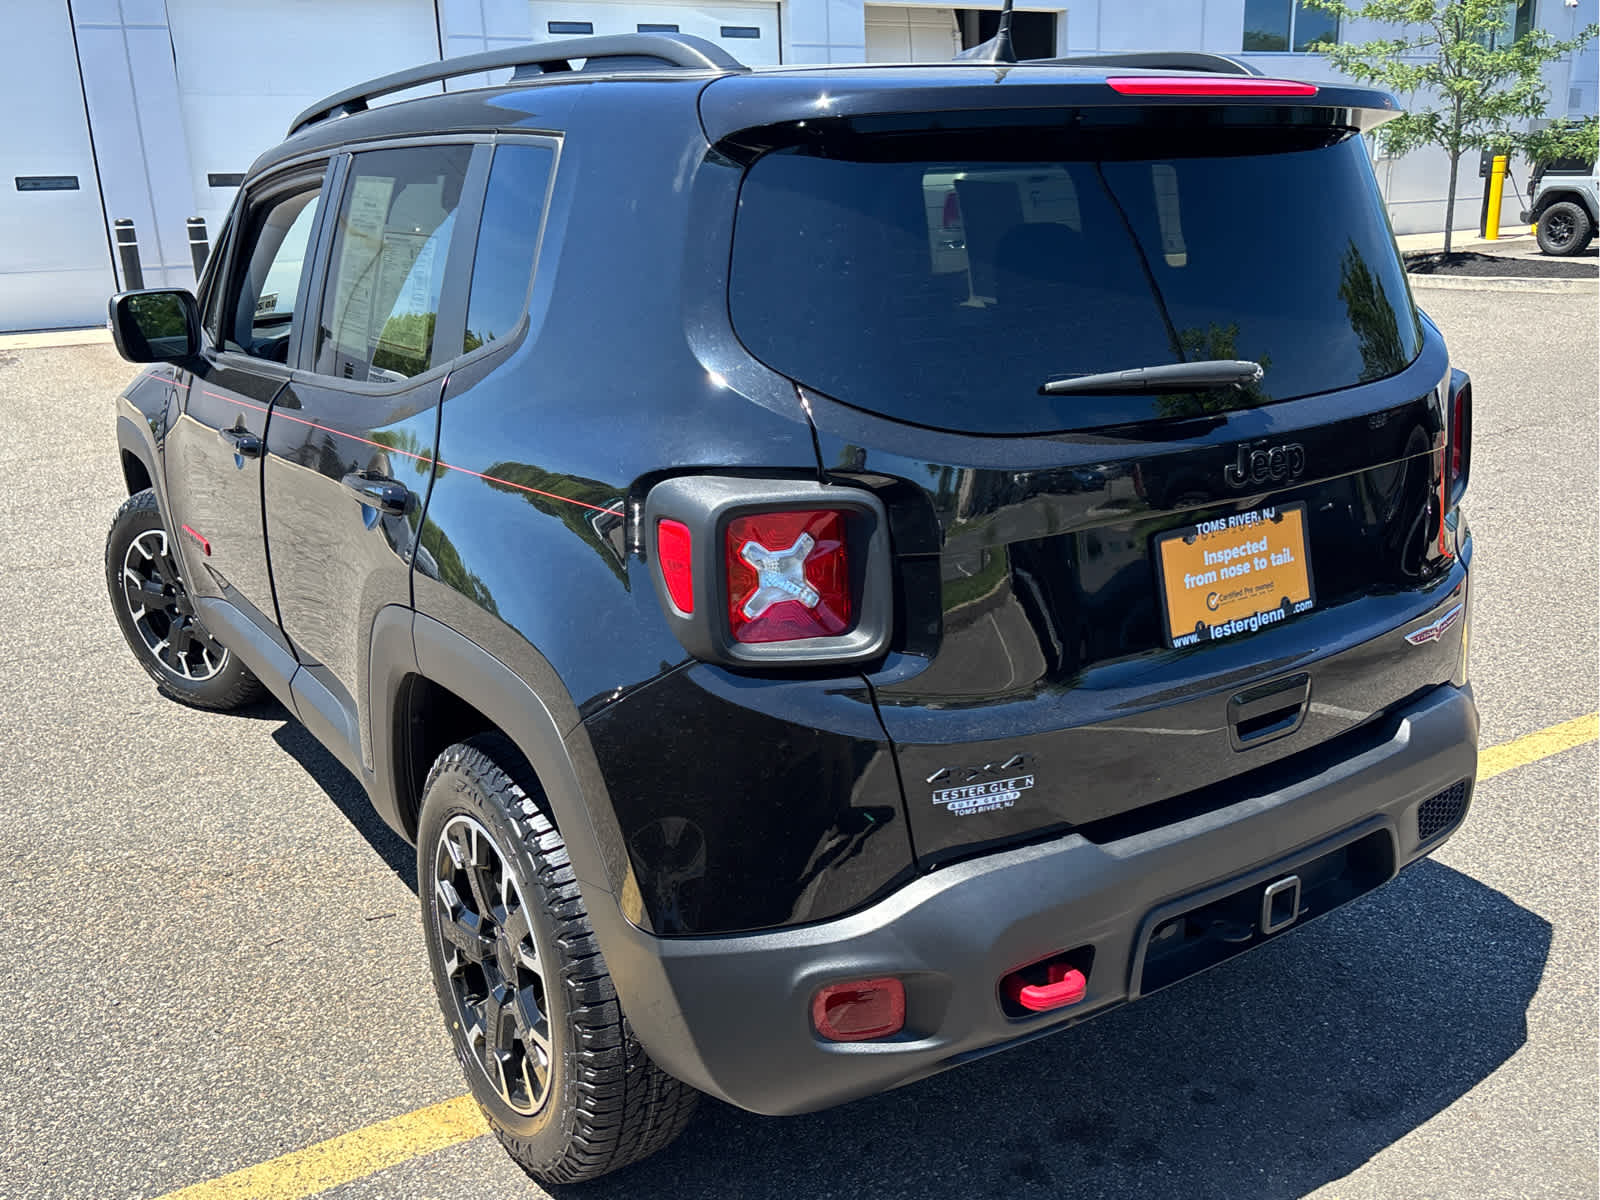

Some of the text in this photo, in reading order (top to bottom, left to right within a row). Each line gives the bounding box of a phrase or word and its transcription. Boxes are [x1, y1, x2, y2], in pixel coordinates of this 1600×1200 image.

[1224, 439, 1305, 489] Jeep
[1195, 518, 1226, 535] TOMS
[1229, 510, 1261, 528] RIVER,
[1263, 507, 1276, 519] NJ
[1203, 536, 1268, 566] Inspected
[1183, 547, 1295, 590] from nose to tail.
[1219, 589, 1244, 602] Certified
[1173, 599, 1313, 648] www. lesterglenn .com
[932, 785, 985, 804] LESTER
[954, 807, 977, 817] TOMS
[1004, 800, 1015, 808] NJ
